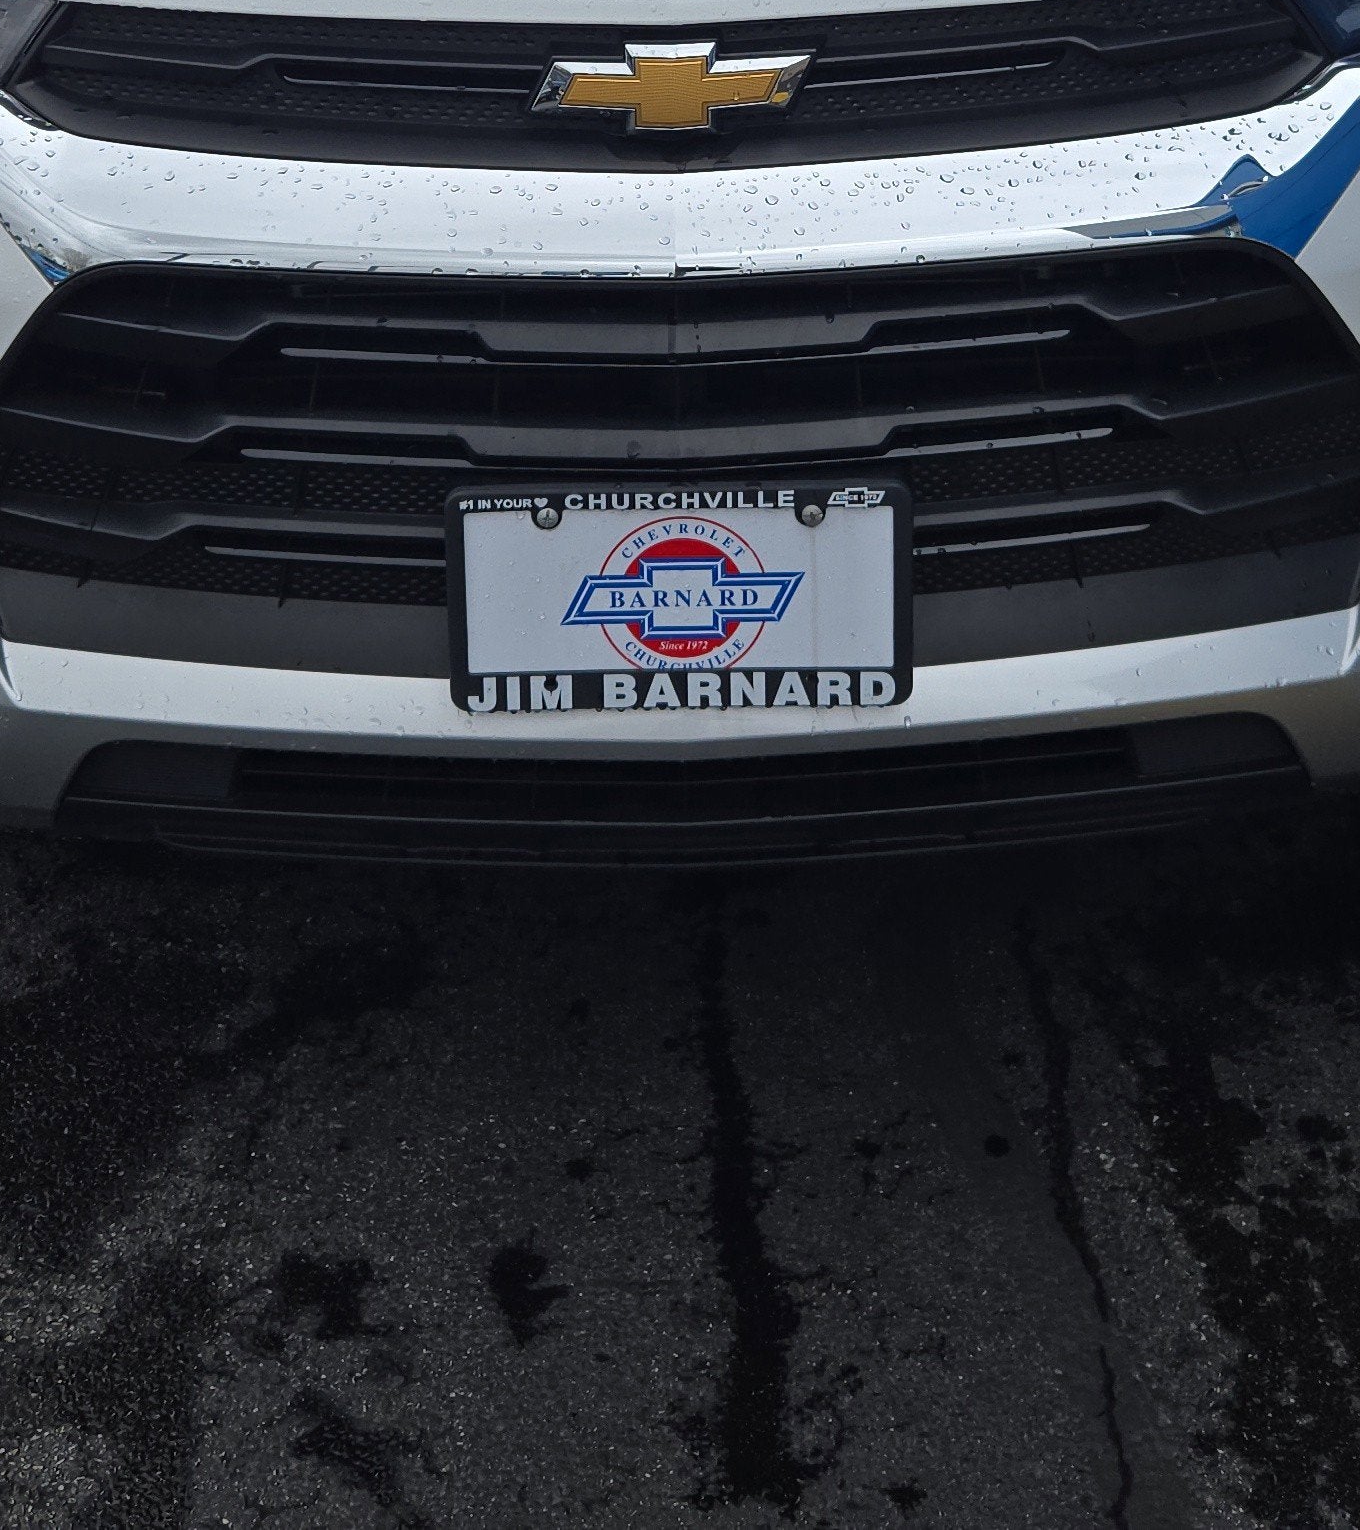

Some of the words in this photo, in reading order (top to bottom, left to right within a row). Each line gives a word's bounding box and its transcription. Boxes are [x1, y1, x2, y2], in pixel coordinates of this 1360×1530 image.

[478, 499, 492, 510] IN
[493, 498, 533, 509] YOUR
[564, 489, 795, 511] CHURCHVILLE
[621, 523, 747, 560] CHEVROLET
[609, 588, 759, 608] BARNARD
[659, 640, 685, 651] Since
[686, 640, 709, 651] 1972
[467, 676, 574, 713] JIM
[603, 672, 897, 710] BARNARD
